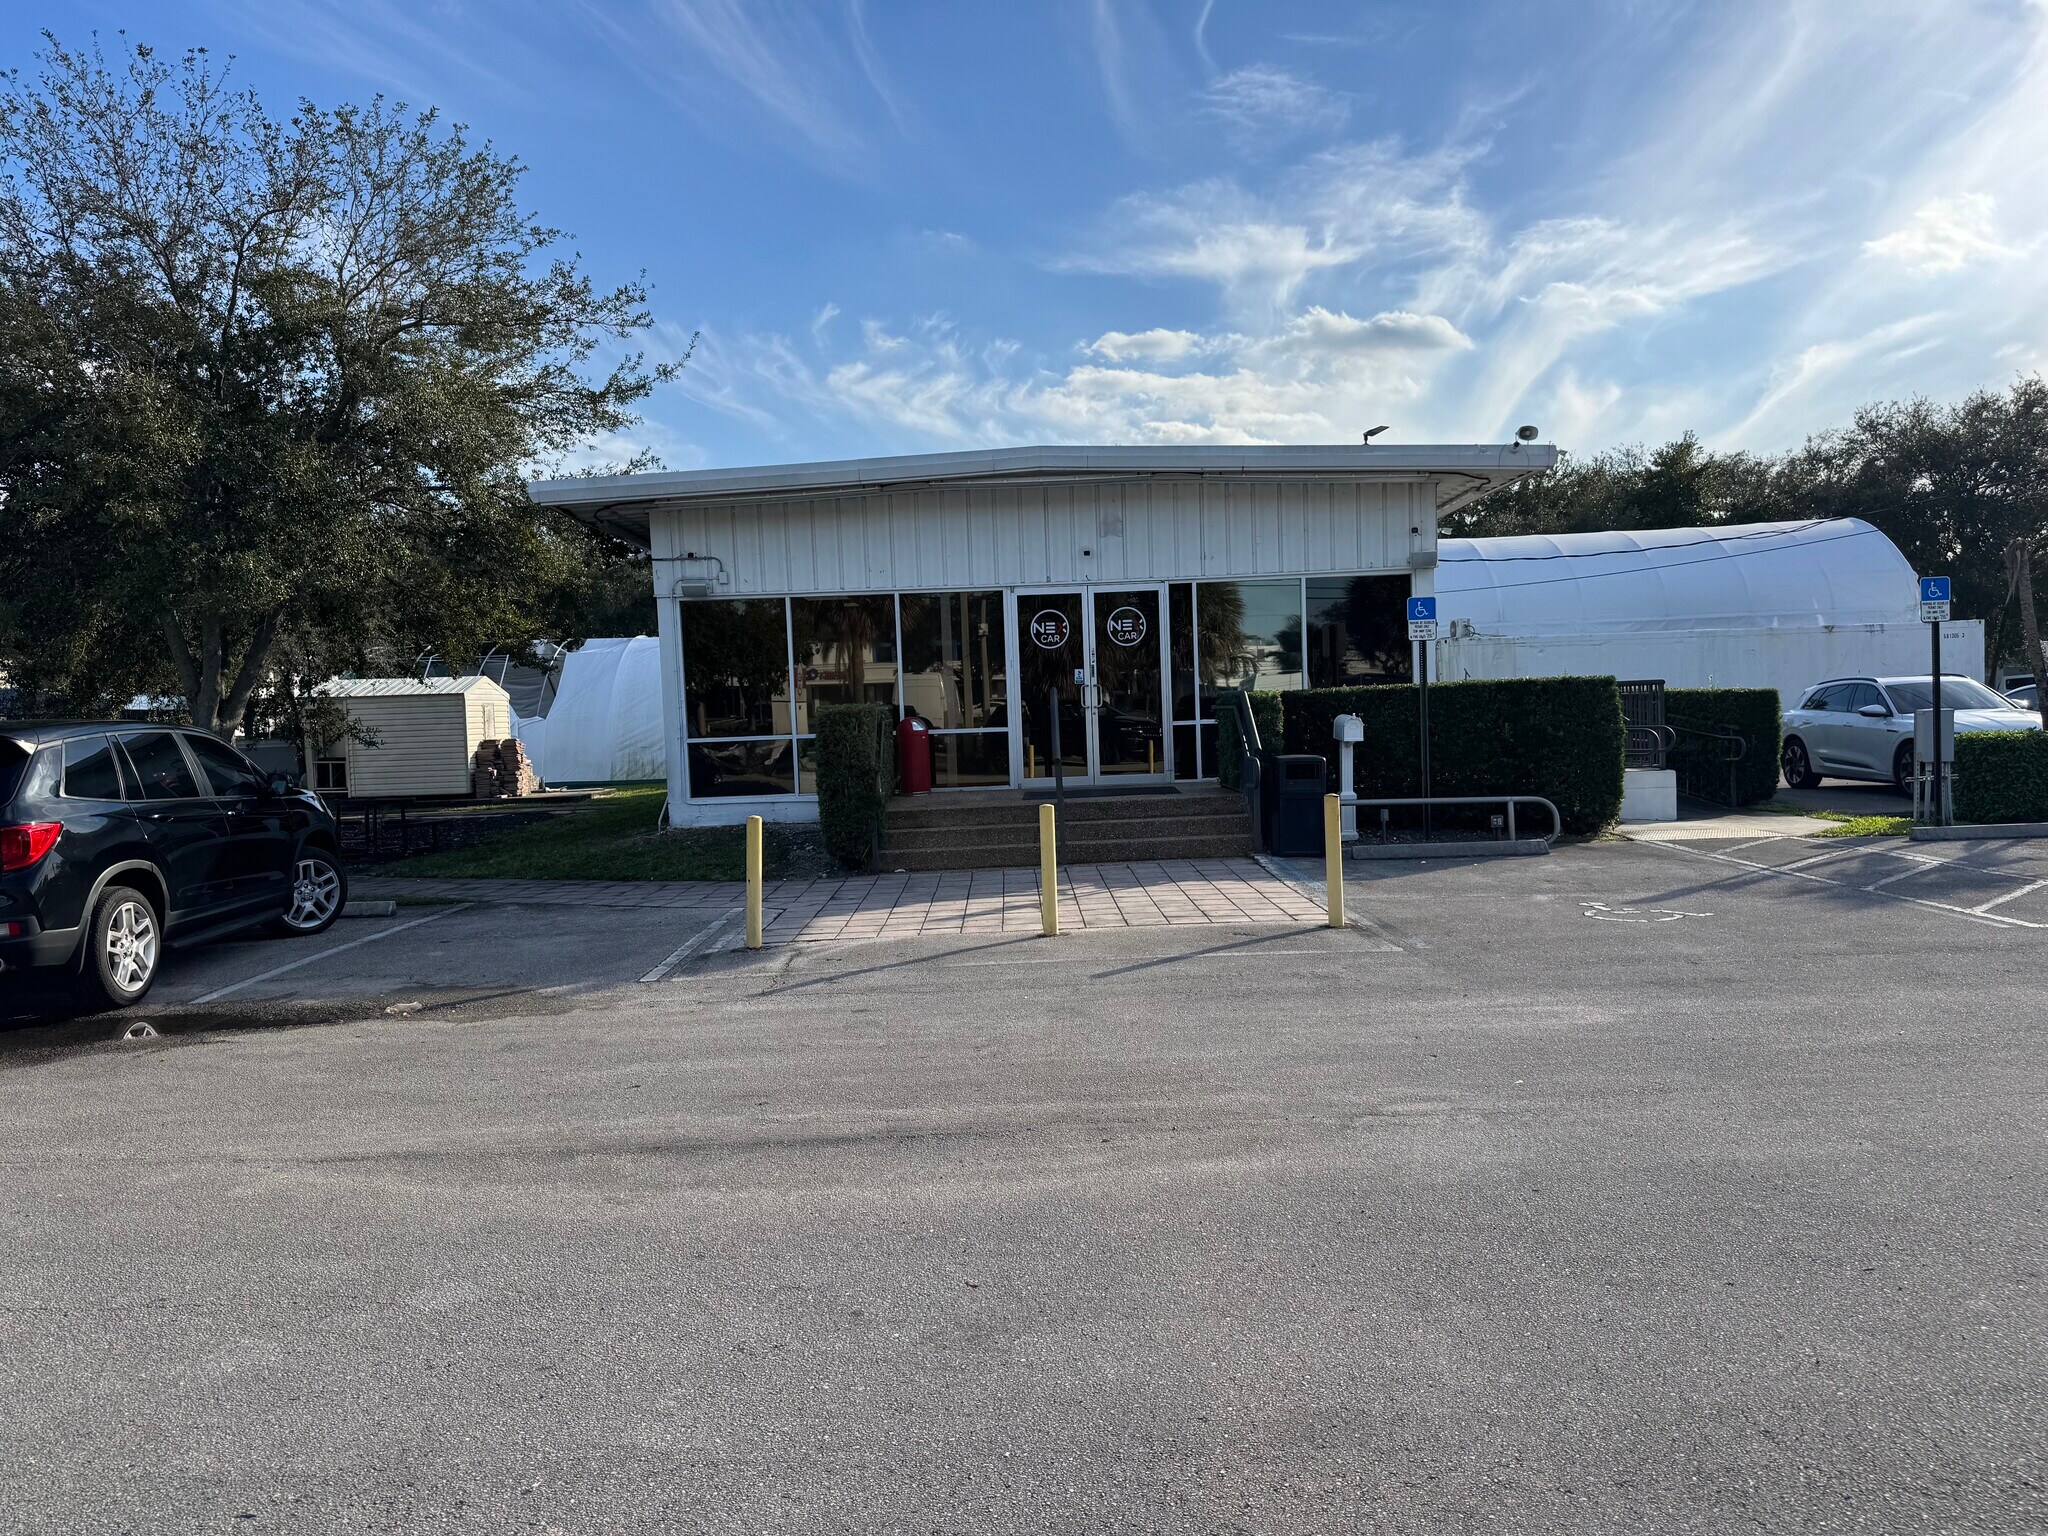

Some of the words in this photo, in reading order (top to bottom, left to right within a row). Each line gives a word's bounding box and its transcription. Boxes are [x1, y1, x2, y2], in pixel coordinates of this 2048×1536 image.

[1033, 622, 1067, 633] NEX
[1111, 619, 1144, 631] NEX
[1041, 635, 1060, 643] CAR
[1118, 632, 1137, 640] CAR
